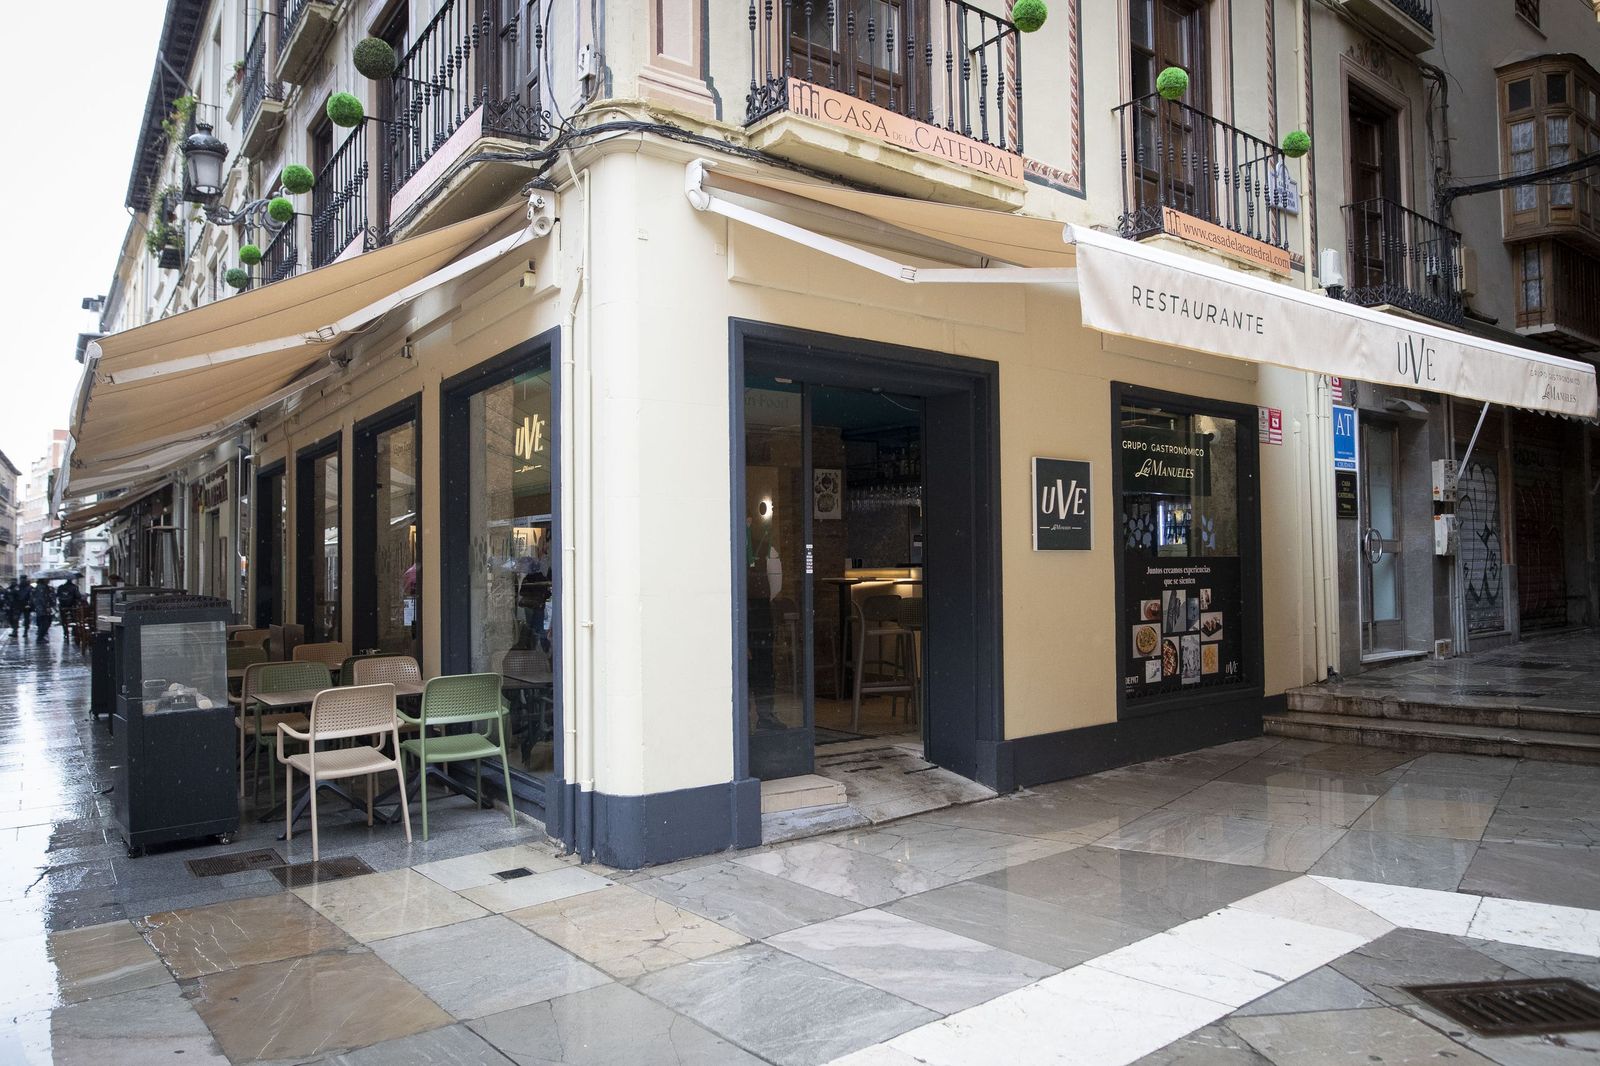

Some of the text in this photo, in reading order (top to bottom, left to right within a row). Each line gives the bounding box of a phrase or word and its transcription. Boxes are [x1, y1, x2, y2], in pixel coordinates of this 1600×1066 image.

[823, 97, 890, 138] CASA
[914, 126, 1019, 179] CATEDRAL
[1183, 222, 1290, 270] www.casadelacatedral.com
[1132, 285, 1264, 335] RESTAURANTE
[1397, 334, 1436, 385] UVE
[515, 413, 545, 460] UVE
[1335, 412, 1353, 437] AT
[1122, 440, 1205, 457] GRUPO GASTRONÓMICO
[1041, 479, 1087, 520] UVE
[1146, 566, 1163, 575] Juntos
[1183, 565, 1211, 576] experiencias
[1163, 578, 1173, 587] que
